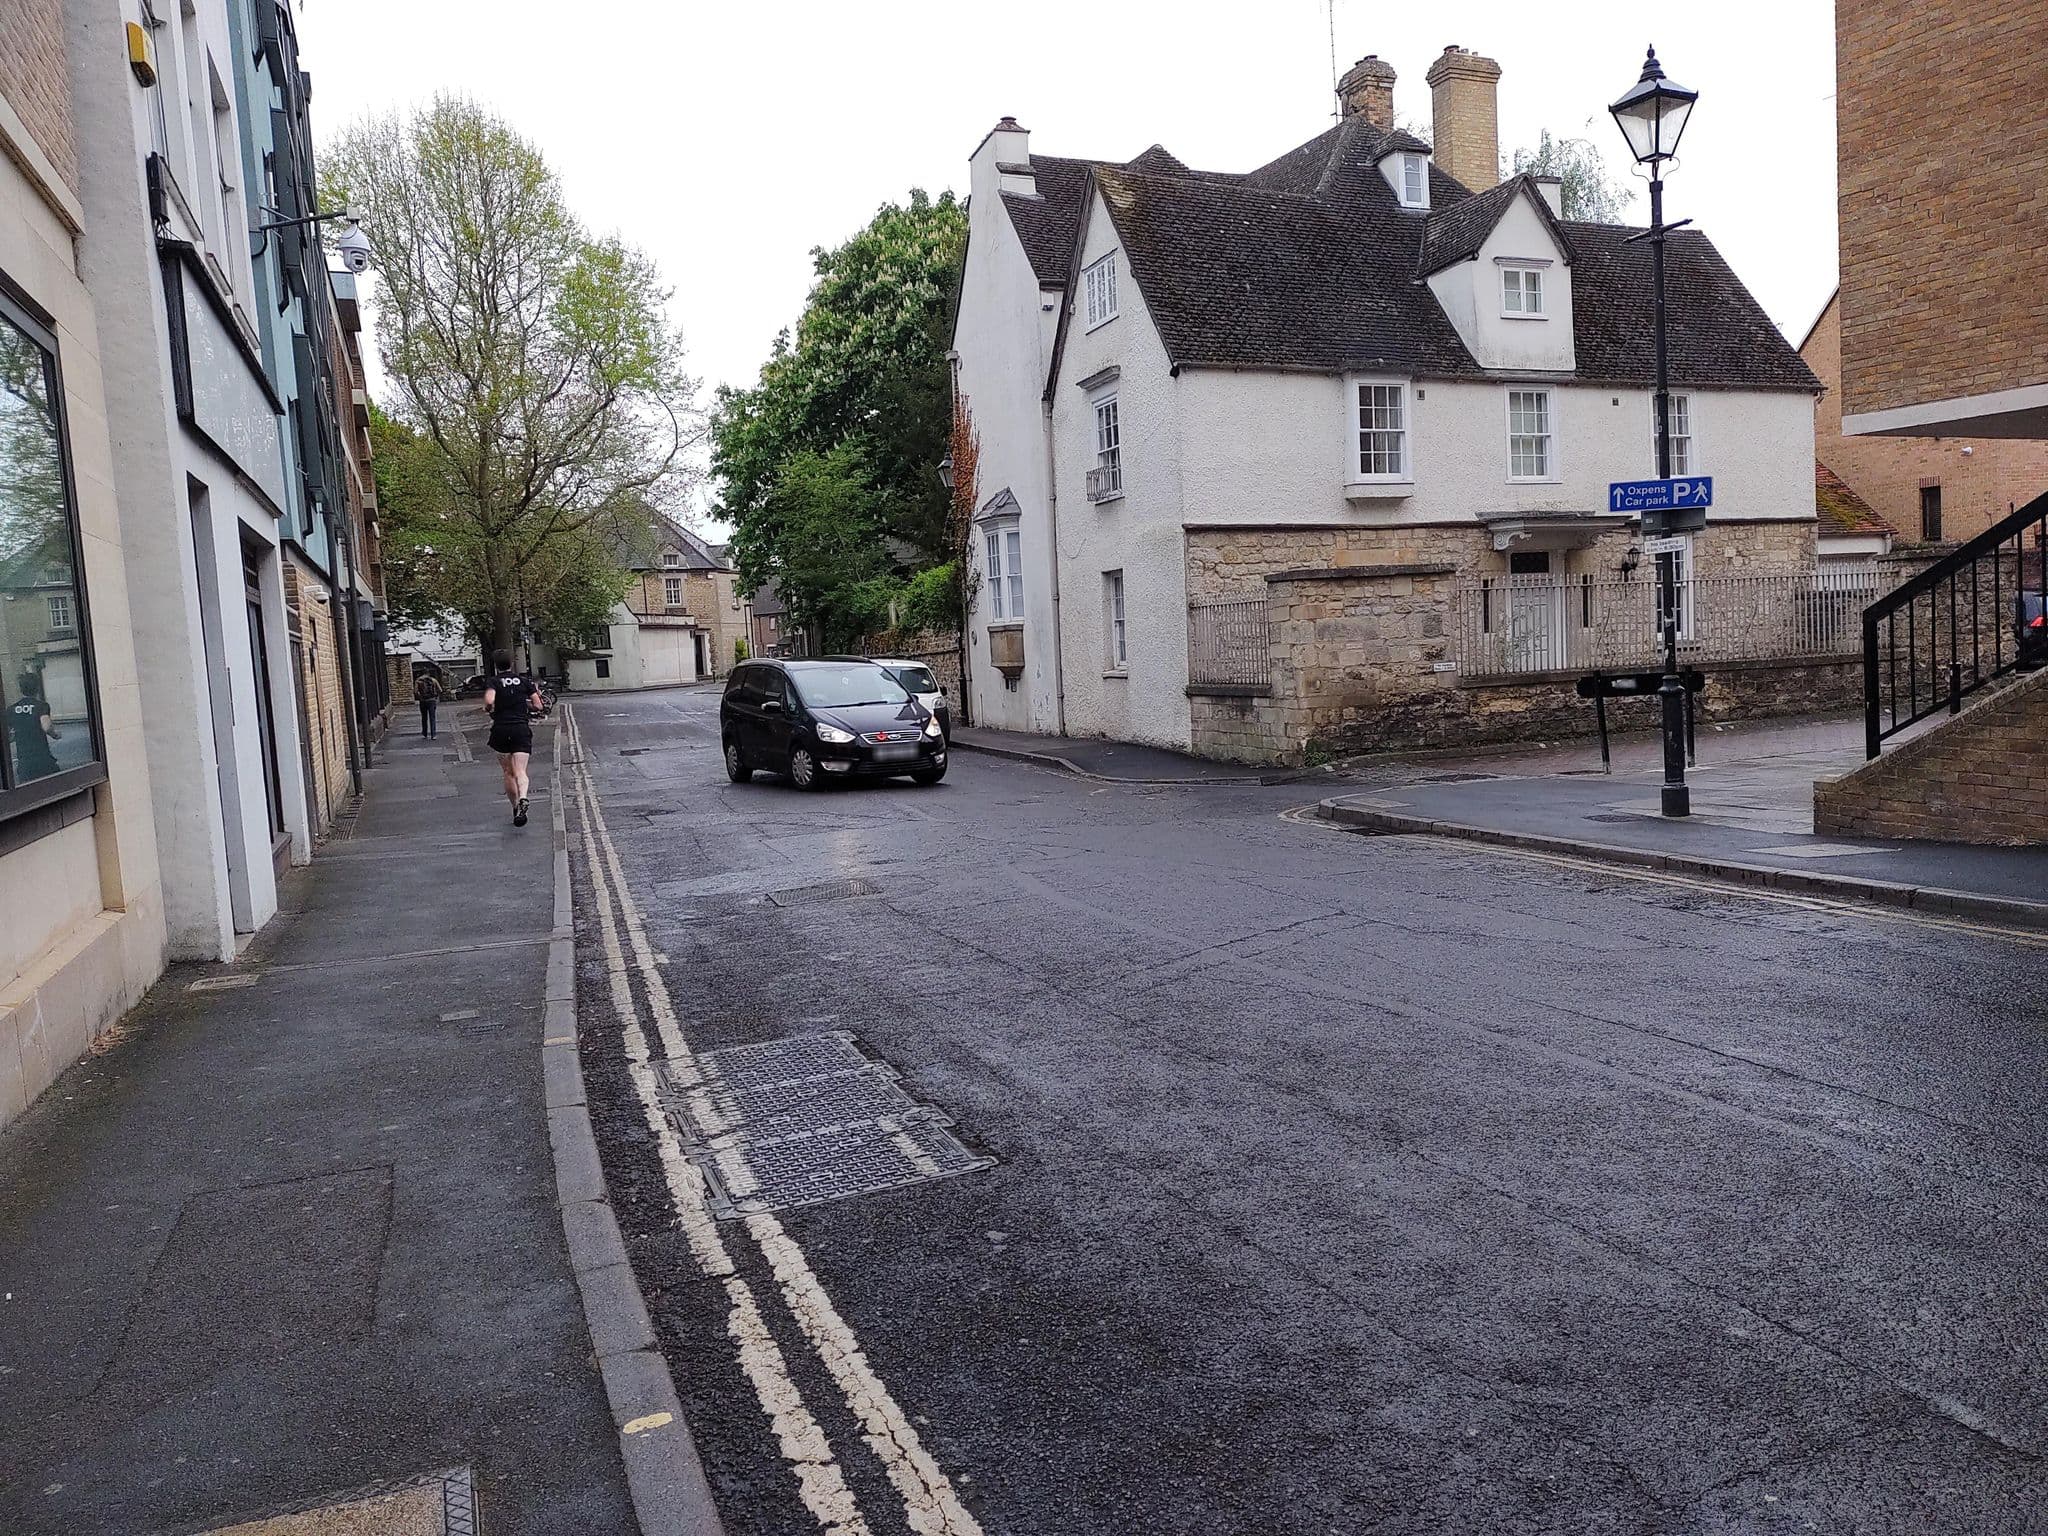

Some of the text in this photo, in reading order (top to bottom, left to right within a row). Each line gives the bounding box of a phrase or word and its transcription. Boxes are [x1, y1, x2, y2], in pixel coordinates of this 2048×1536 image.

[1627, 486, 1667, 497] Oxpens
[1672, 482, 1691, 505] P
[1625, 496, 1669, 507] Car park
[501, 677, 521, 687] 100
